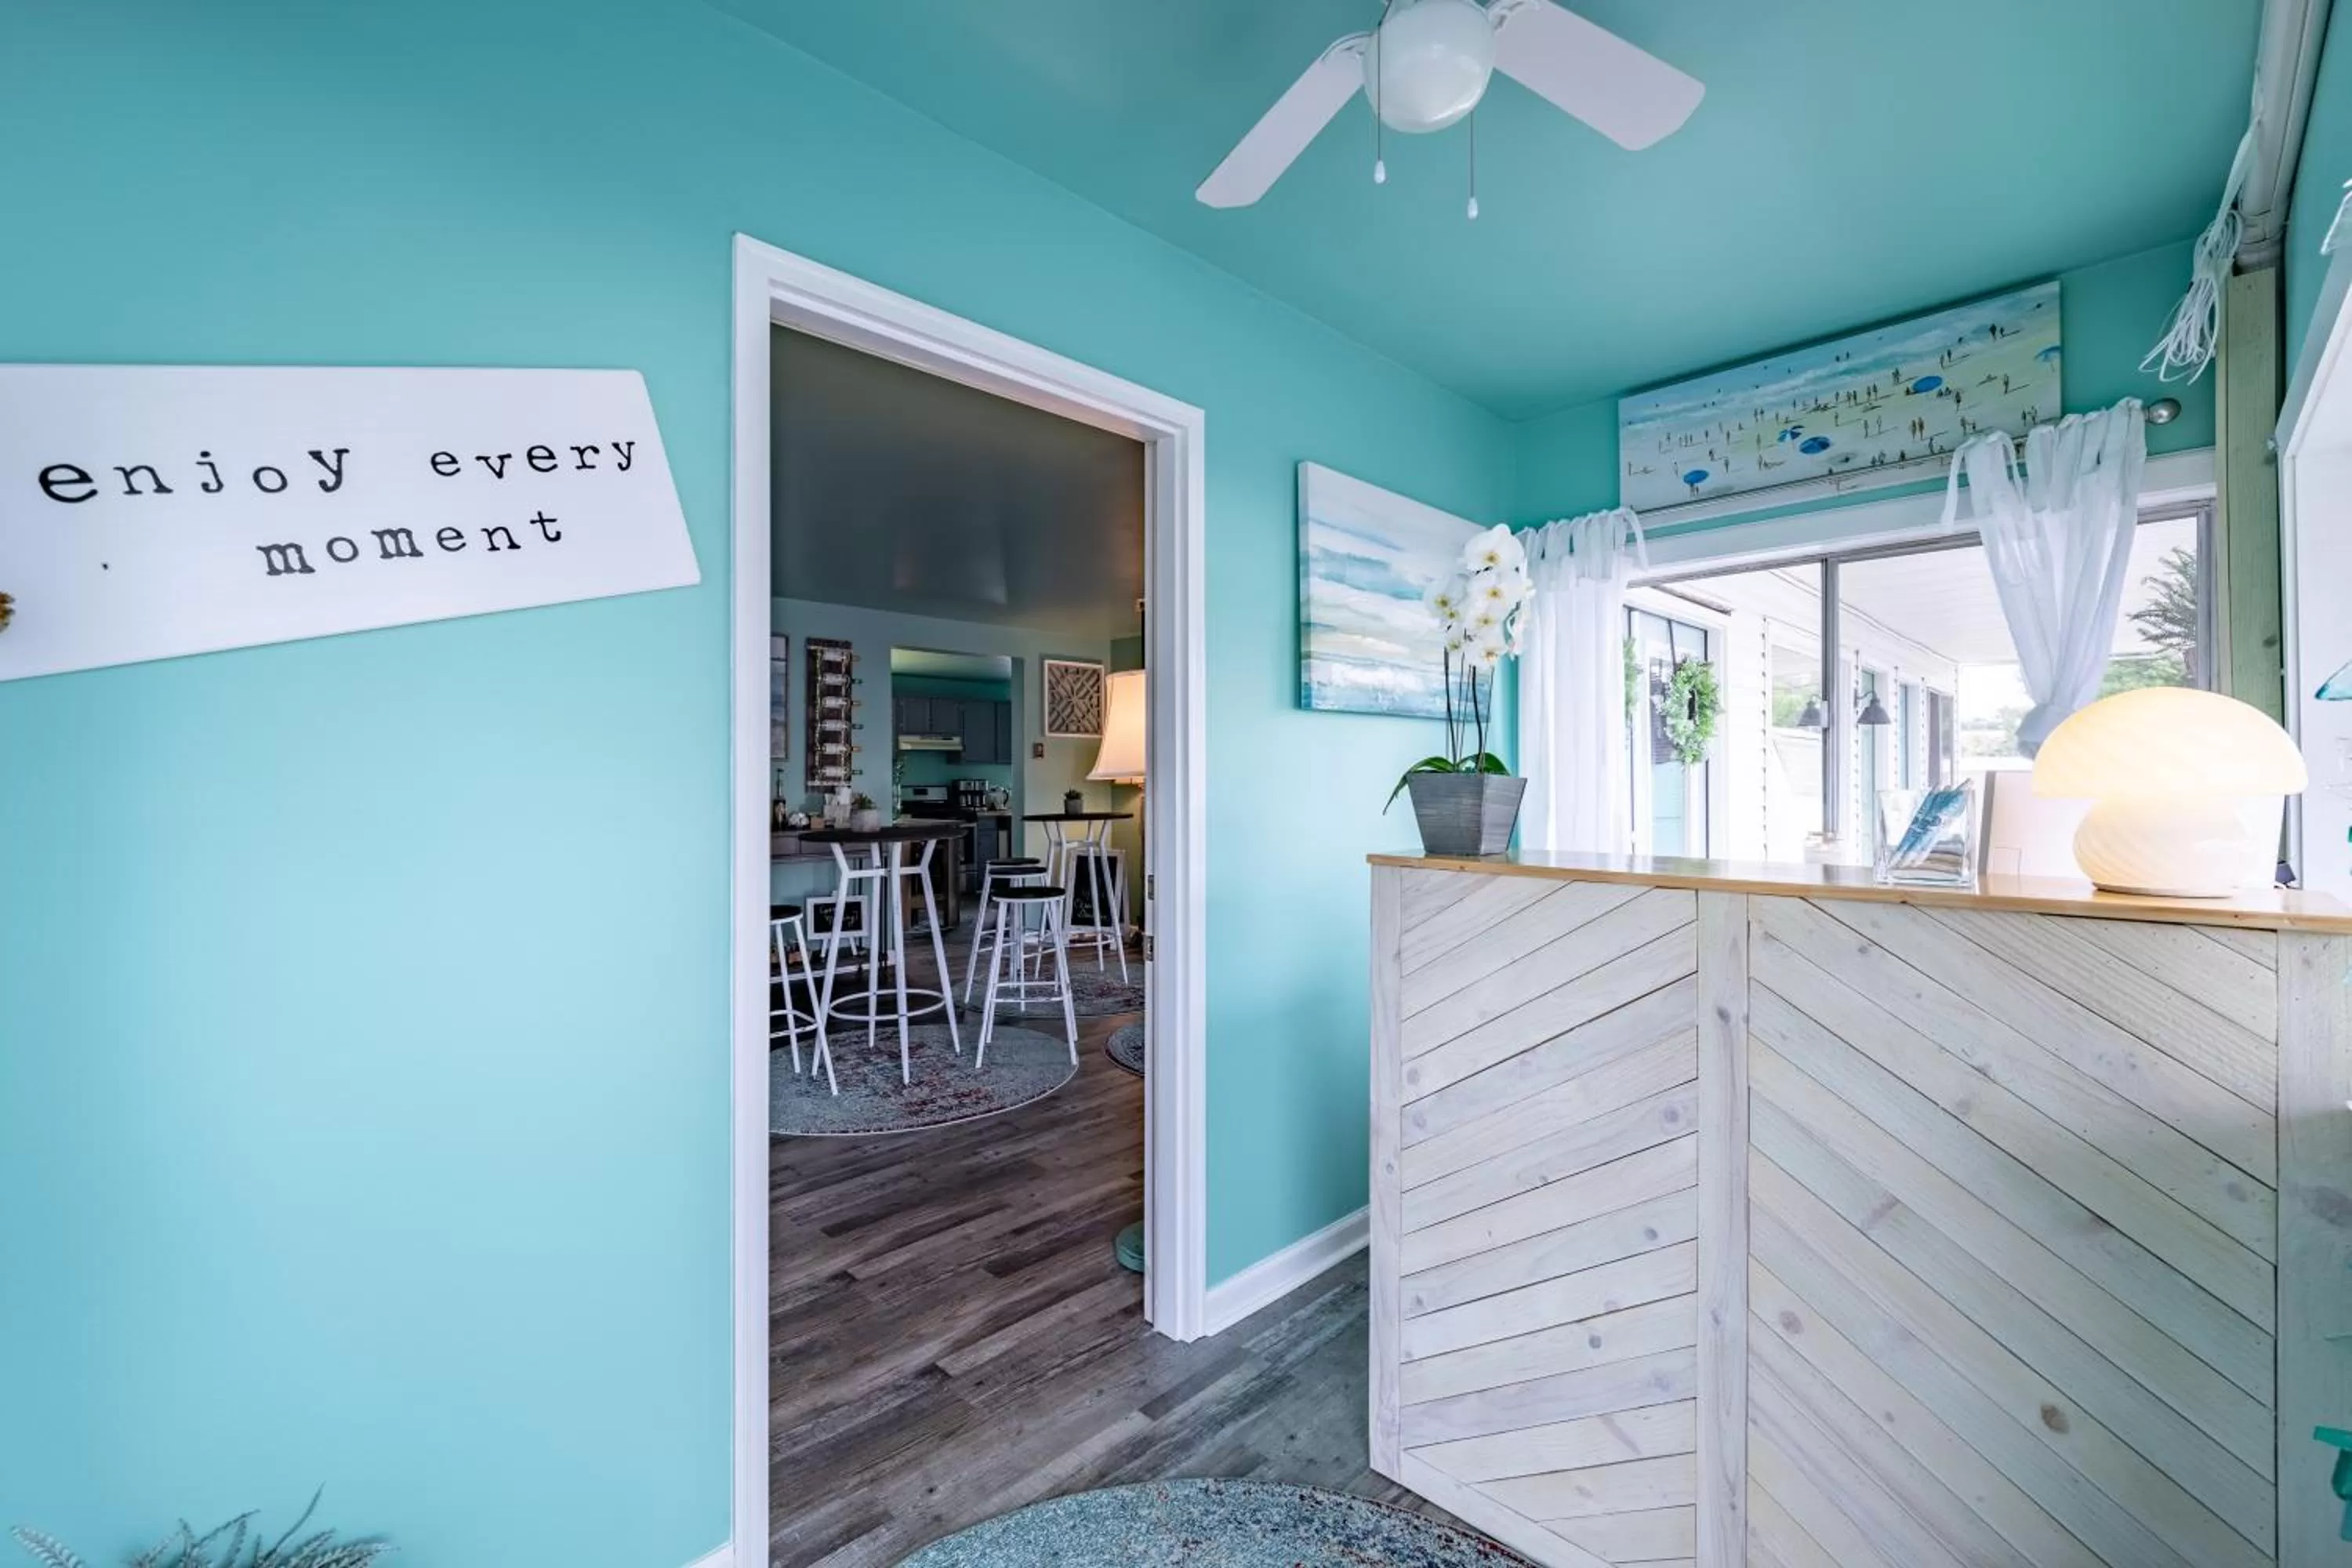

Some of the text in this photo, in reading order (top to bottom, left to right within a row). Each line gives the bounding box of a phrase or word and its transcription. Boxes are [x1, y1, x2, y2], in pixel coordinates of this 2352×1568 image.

[38, 441, 636, 504] enjoy every
[256, 510, 562, 576] moment
